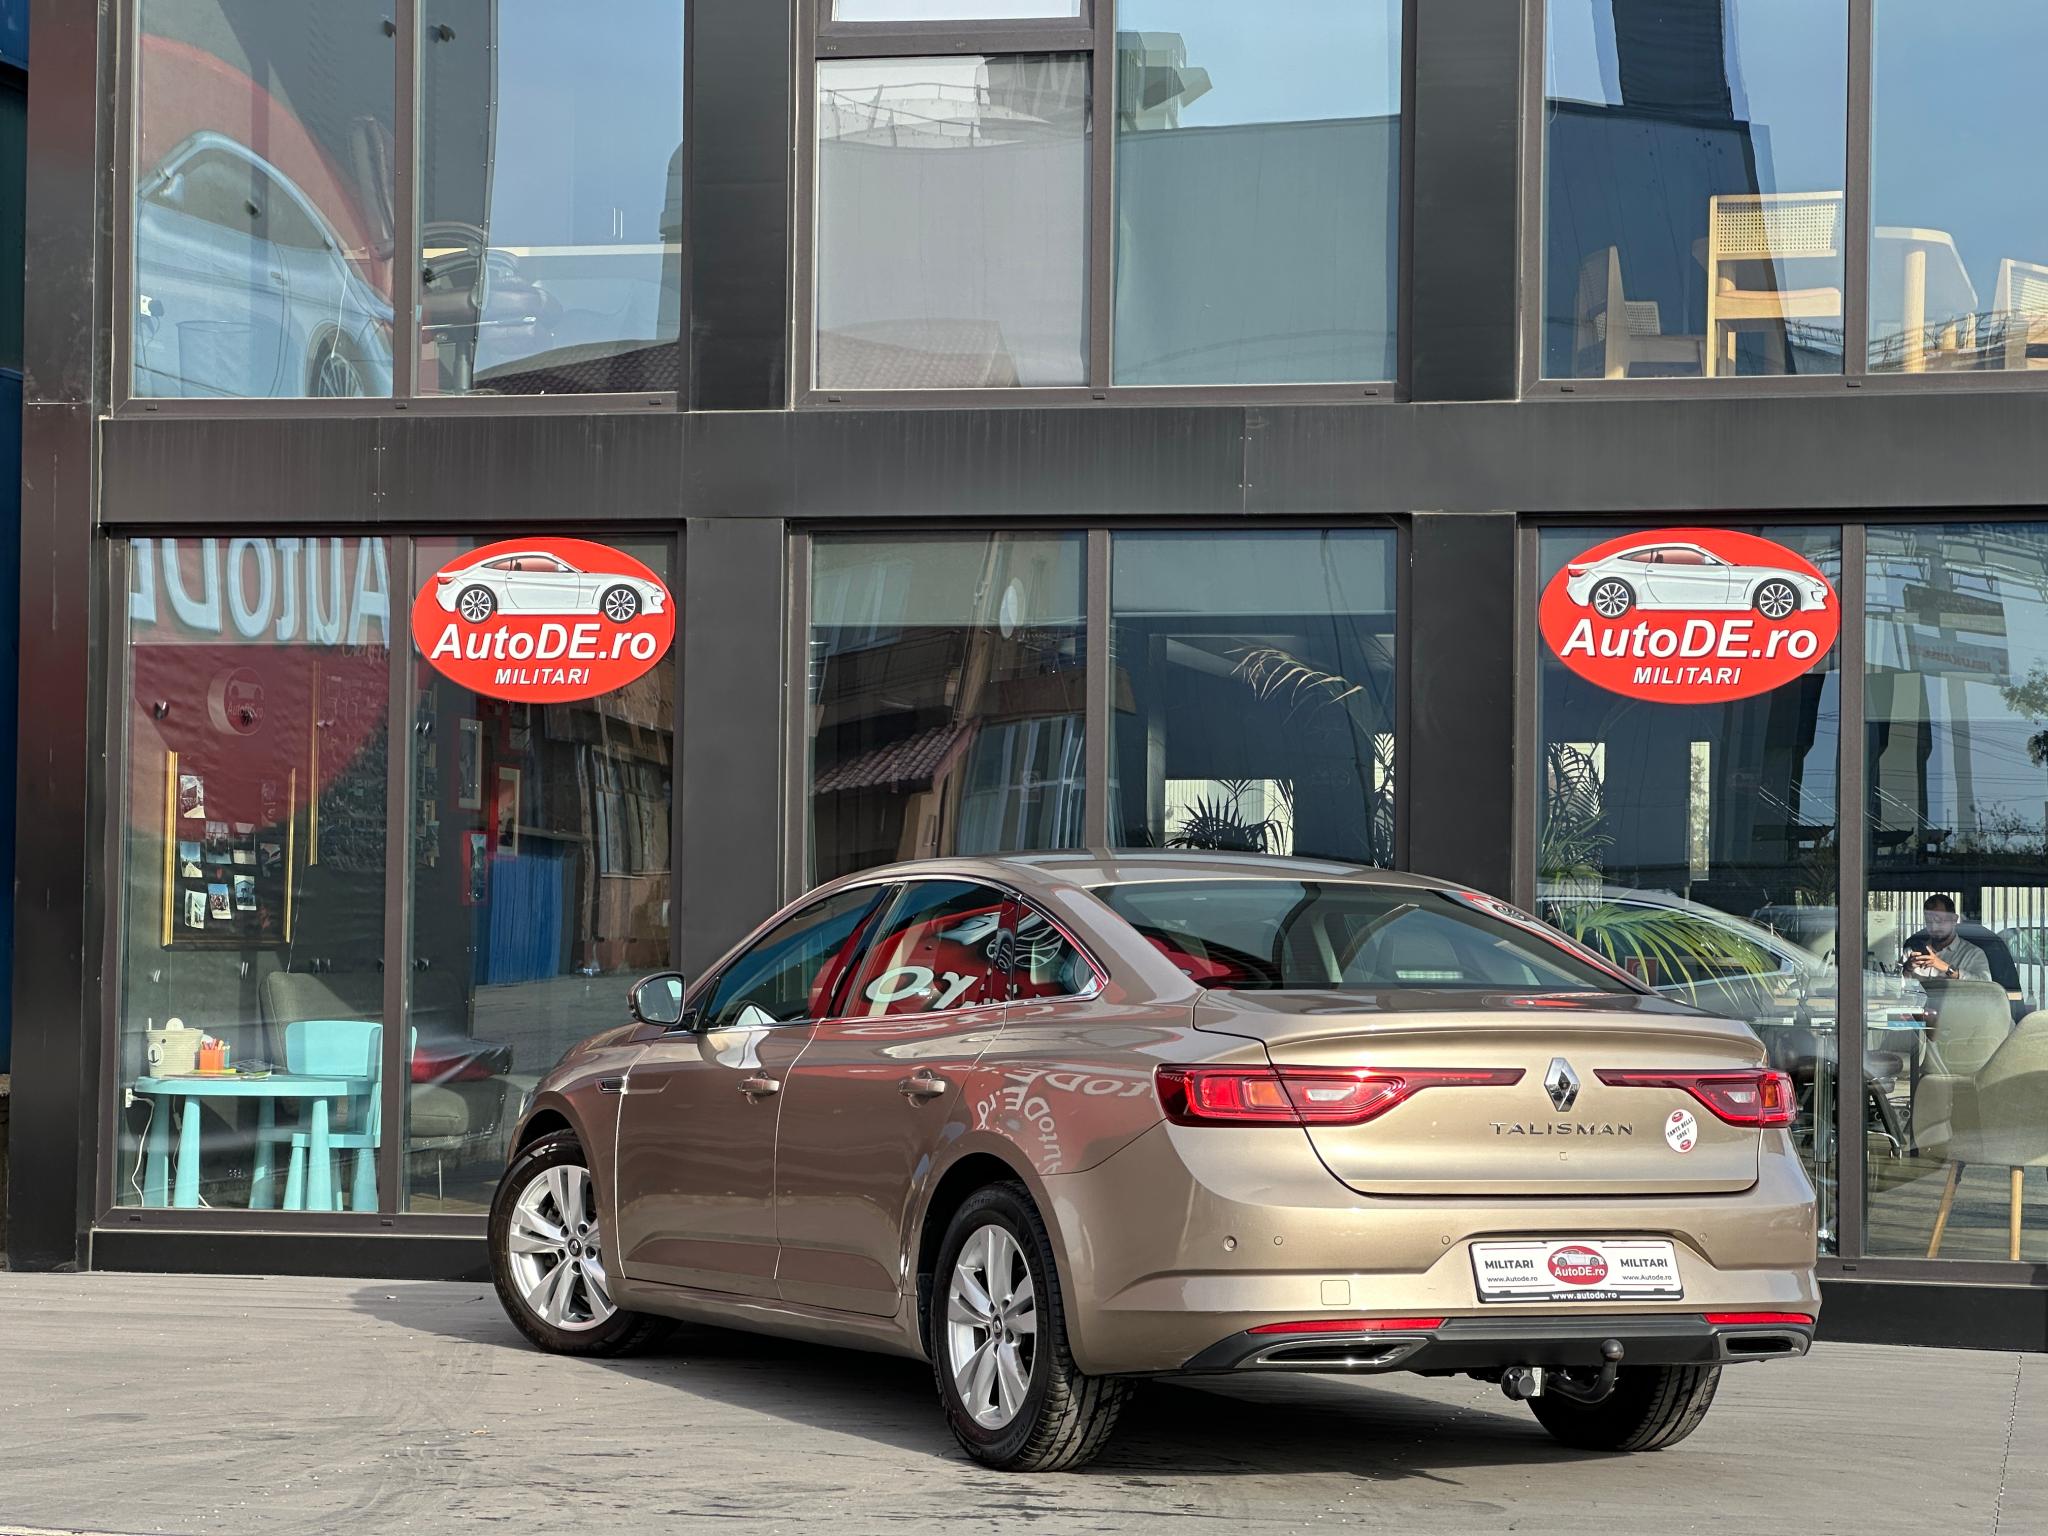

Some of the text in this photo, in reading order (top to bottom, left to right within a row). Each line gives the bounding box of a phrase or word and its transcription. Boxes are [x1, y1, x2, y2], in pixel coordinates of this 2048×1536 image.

[431, 623, 657, 661] AutoDE.ro
[1560, 618, 1818, 659] AutoDE.ro
[494, 667, 590, 685] MILITARI
[1632, 666, 1742, 685] MILITARI
[1489, 1122, 1633, 1135] TALISMAN
[1484, 1259, 1534, 1270] MILITARI
[1620, 1258, 1668, 1268] MILITARI
[1554, 1266, 1606, 1278] AutoDE.ro
